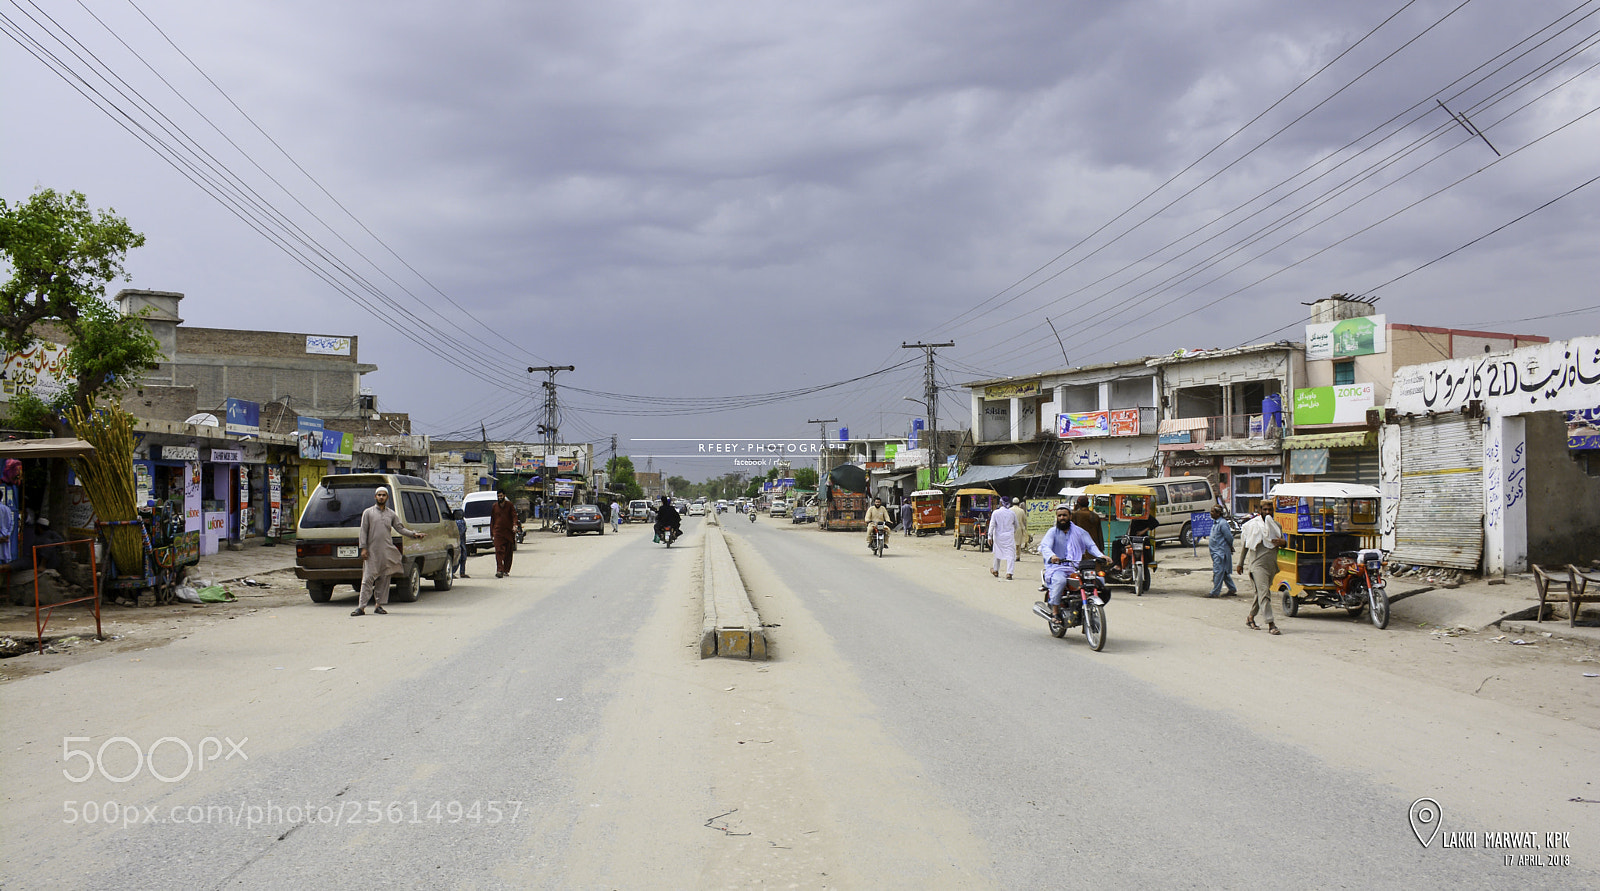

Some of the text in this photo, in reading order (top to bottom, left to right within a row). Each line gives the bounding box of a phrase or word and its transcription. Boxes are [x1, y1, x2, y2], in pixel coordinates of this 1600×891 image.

[1423, 365, 1470, 408] سروس
[1463, 358, 1489, 403] کار
[1519, 351, 1571, 405] زیب
[207, 516, 225, 531] ufone
